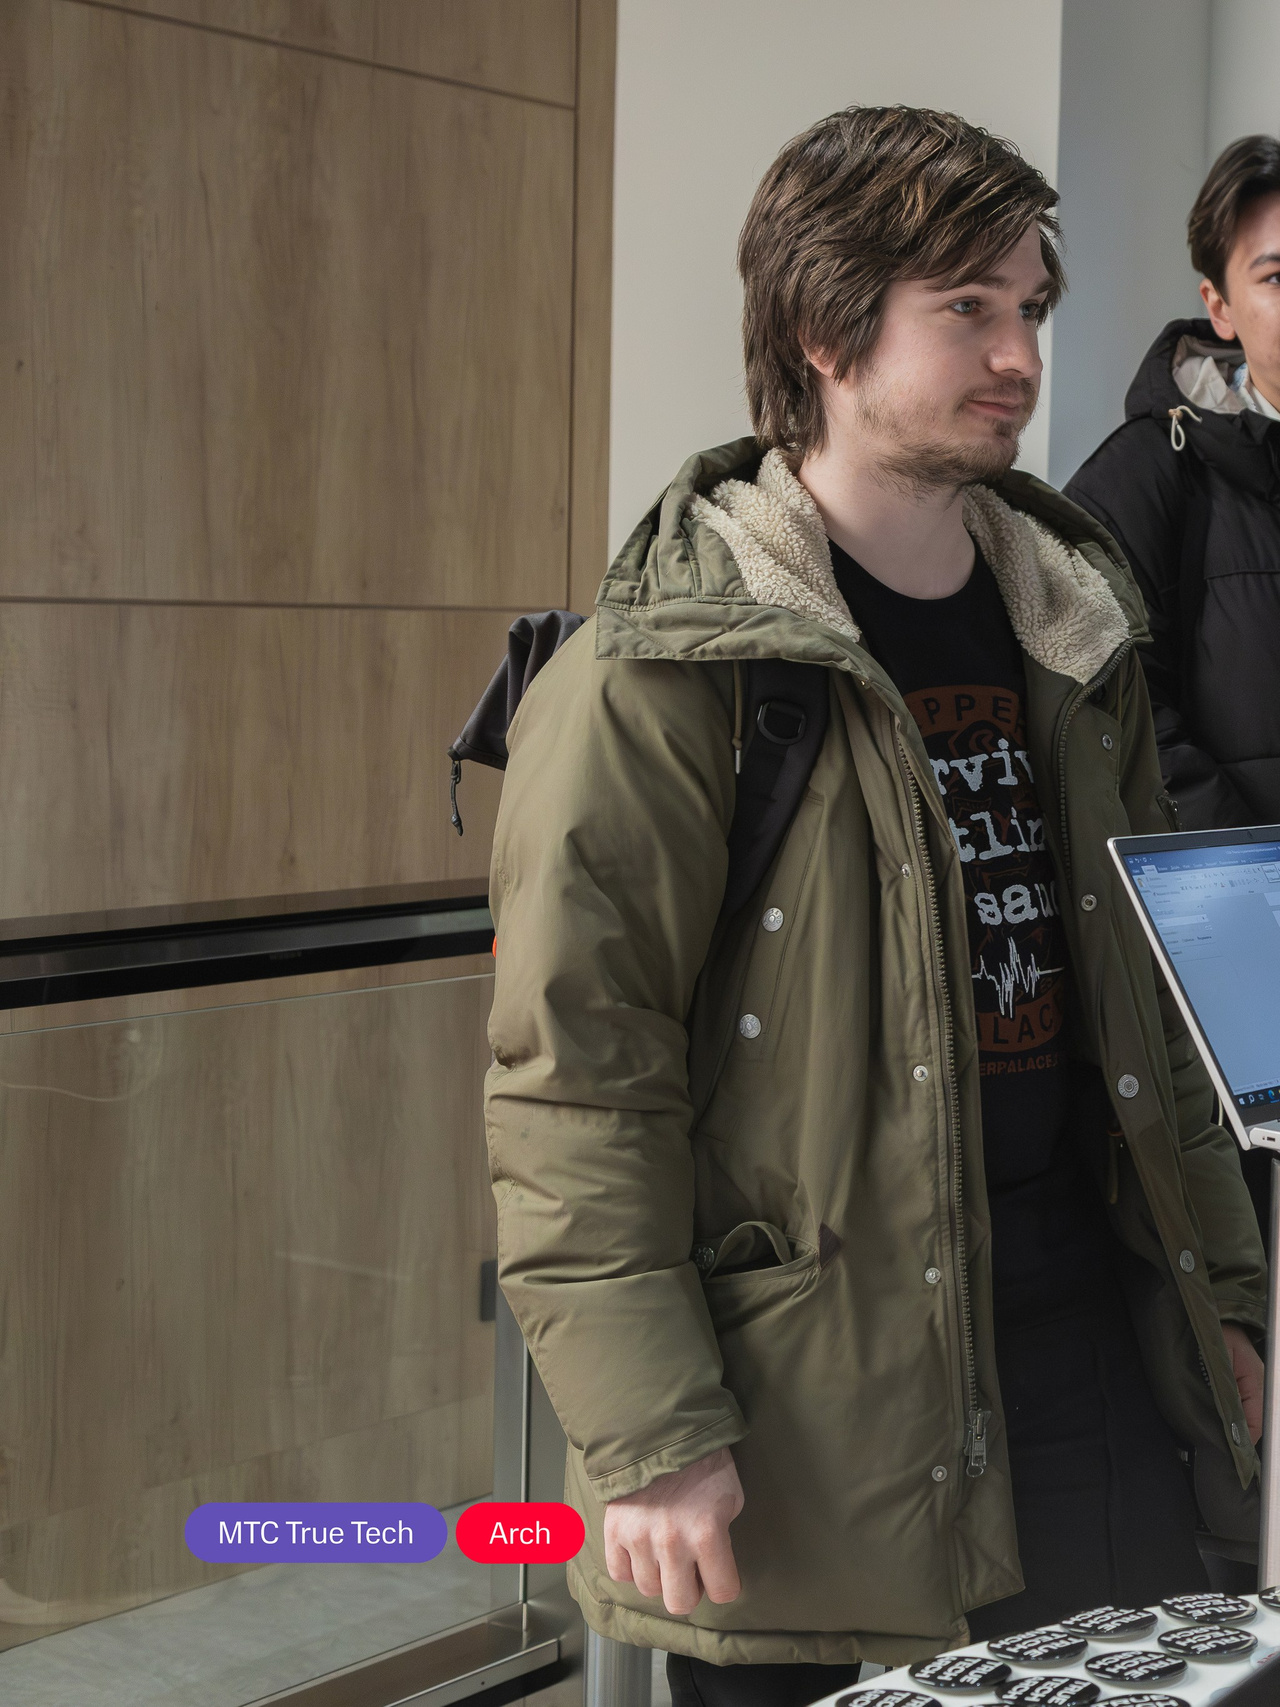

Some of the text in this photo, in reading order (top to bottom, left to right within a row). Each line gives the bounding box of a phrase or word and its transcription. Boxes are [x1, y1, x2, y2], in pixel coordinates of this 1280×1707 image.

[915, 693, 1016, 729] PPE
[1162, 1592, 1225, 1605] ARCH
[1174, 1598, 1241, 1611] TECH
[1062, 1605, 1114, 1625] ARCH
[1079, 1608, 1135, 1628] TECH
[1187, 1604, 1254, 1619] TRUE
[1097, 1612, 1153, 1632] TRUE
[989, 1630, 1047, 1649] ARCH
[1006, 1633, 1067, 1653] TECH
[1160, 1625, 1220, 1641] ARCH
[1175, 1629, 1240, 1647] TECH
[1023, 1637, 1085, 1658] TRUE
[1191, 1634, 1255, 1654] TRUE
[915, 1656, 957, 1679] ARCH
[937, 1658, 981, 1681] TECH
[1087, 1651, 1142, 1669] ARCH
[1105, 1653, 1165, 1674] TECH
[1124, 1658, 1183, 1679] TRUE
[959, 1661, 1003, 1685] TRUE
[1002, 1675, 1046, 1700] ARCH
[1024, 1677, 1070, 1702] TECH
[1047, 1680, 1092, 1706] TRUE
[874, 1691, 911, 1707] TEC
